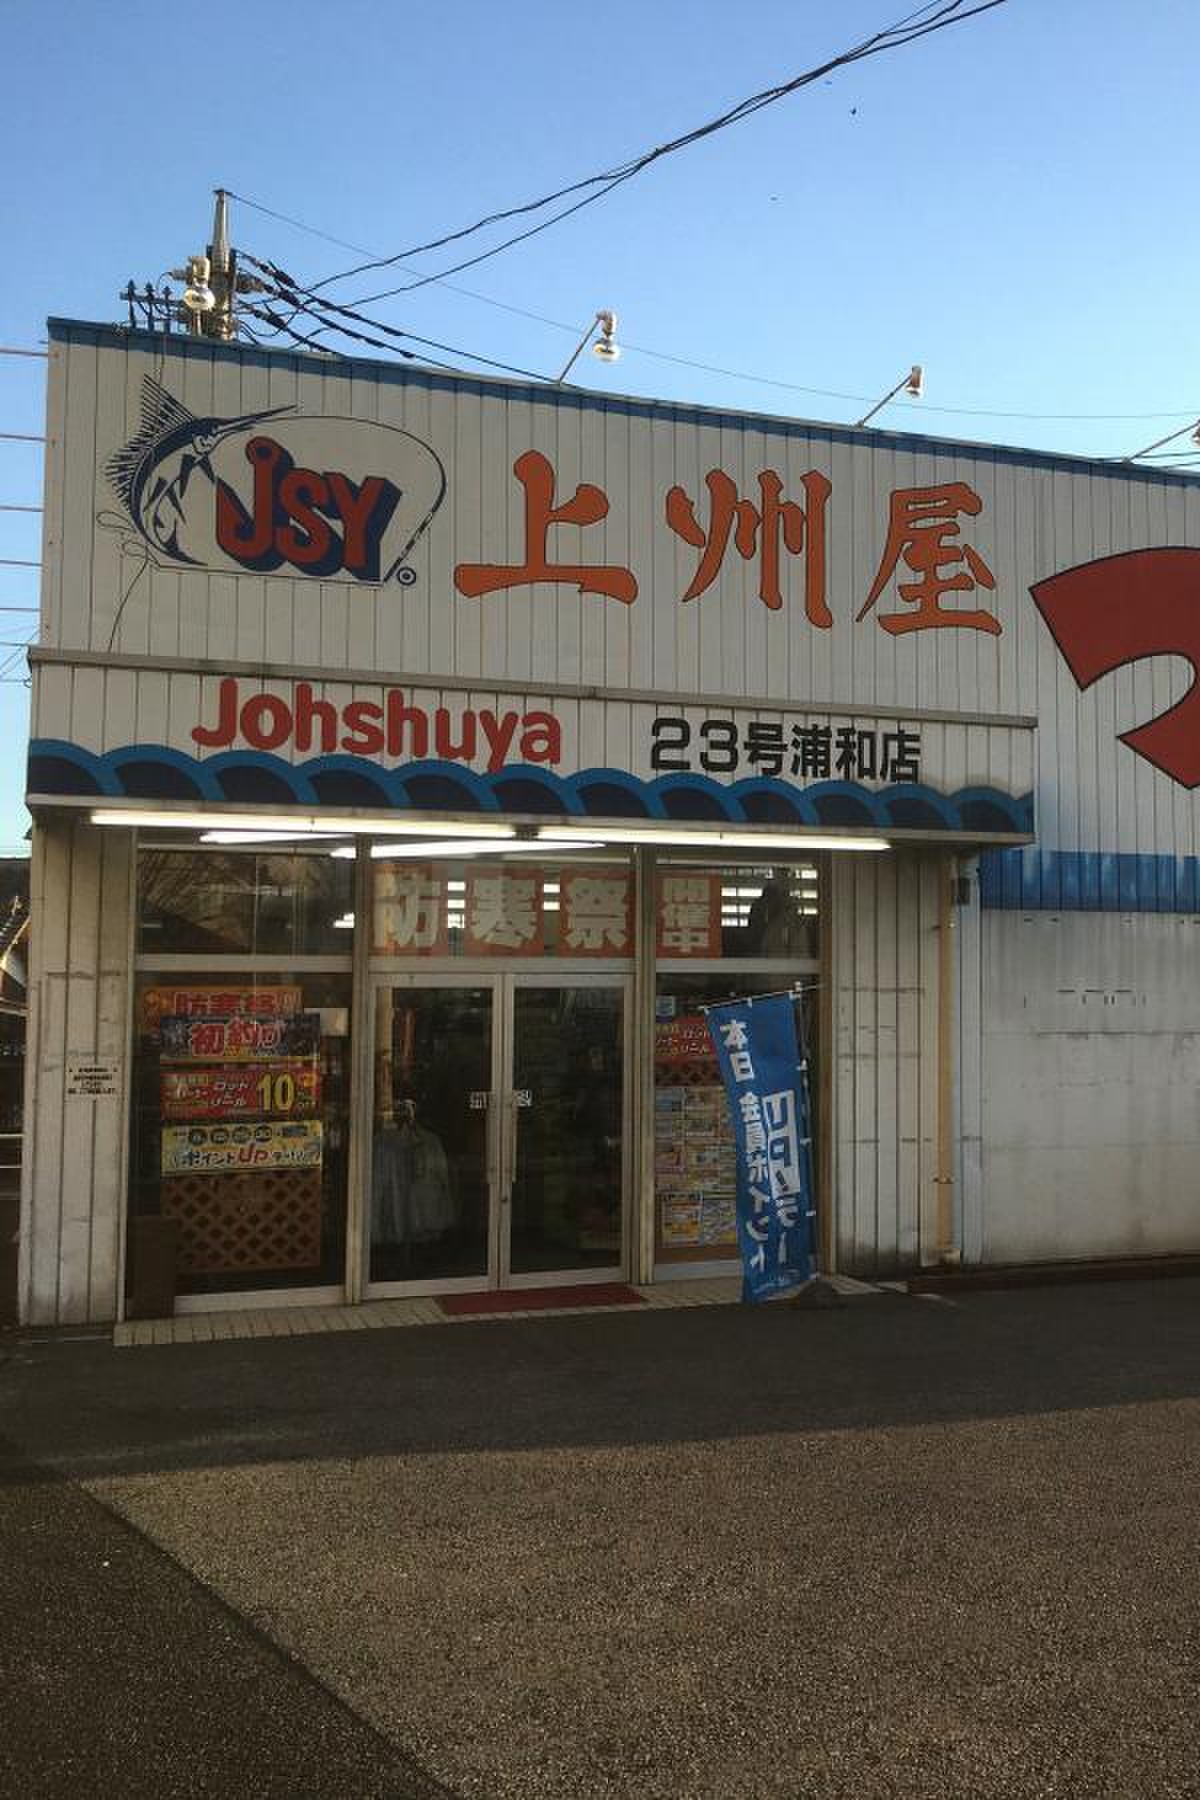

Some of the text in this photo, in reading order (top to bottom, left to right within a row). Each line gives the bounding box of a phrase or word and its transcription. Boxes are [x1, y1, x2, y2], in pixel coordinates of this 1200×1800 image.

[215, 436, 402, 582] JSY
[453, 449, 1002, 637] 上州屋
[191, 677, 562, 774] Johshuya
[650, 716, 922, 784] 23号浦和店
[256, 1071, 295, 1111] 10
